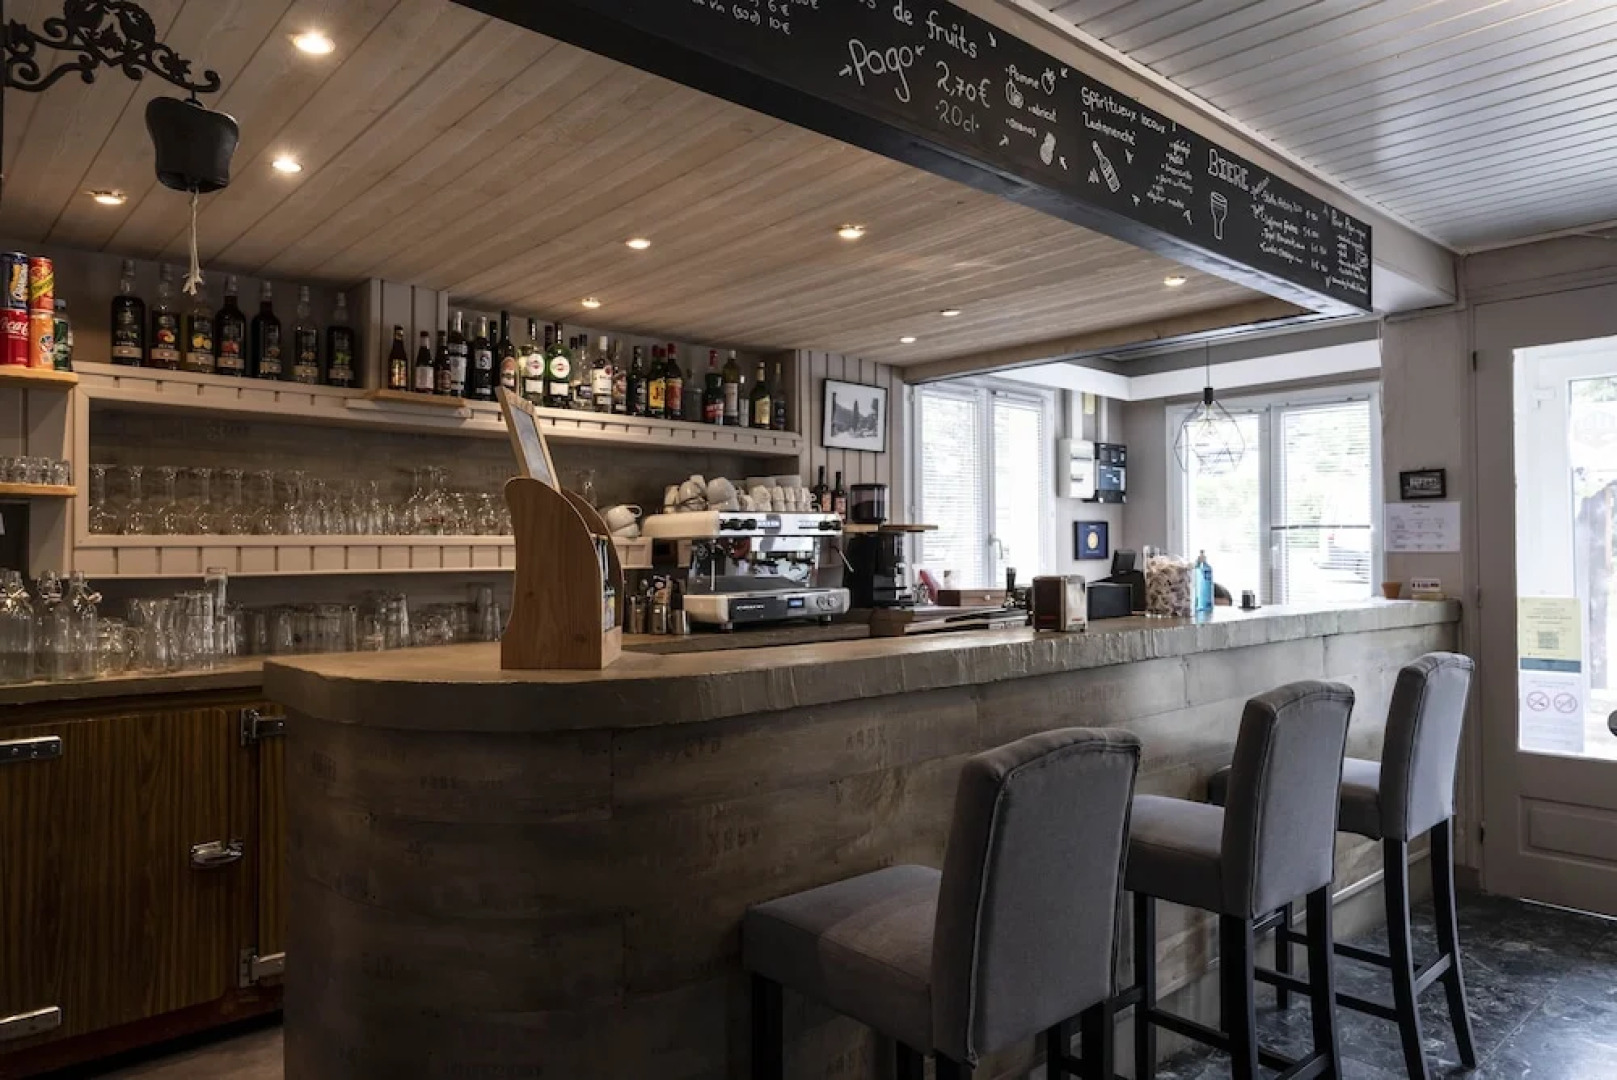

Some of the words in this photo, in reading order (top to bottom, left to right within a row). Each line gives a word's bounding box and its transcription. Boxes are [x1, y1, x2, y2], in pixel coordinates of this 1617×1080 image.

[893, 0, 914, 26] de
[925, 9, 977, 59] fruits
[848, 38, 914, 103] Pago
[935, 60, 991, 108] 2,70€
